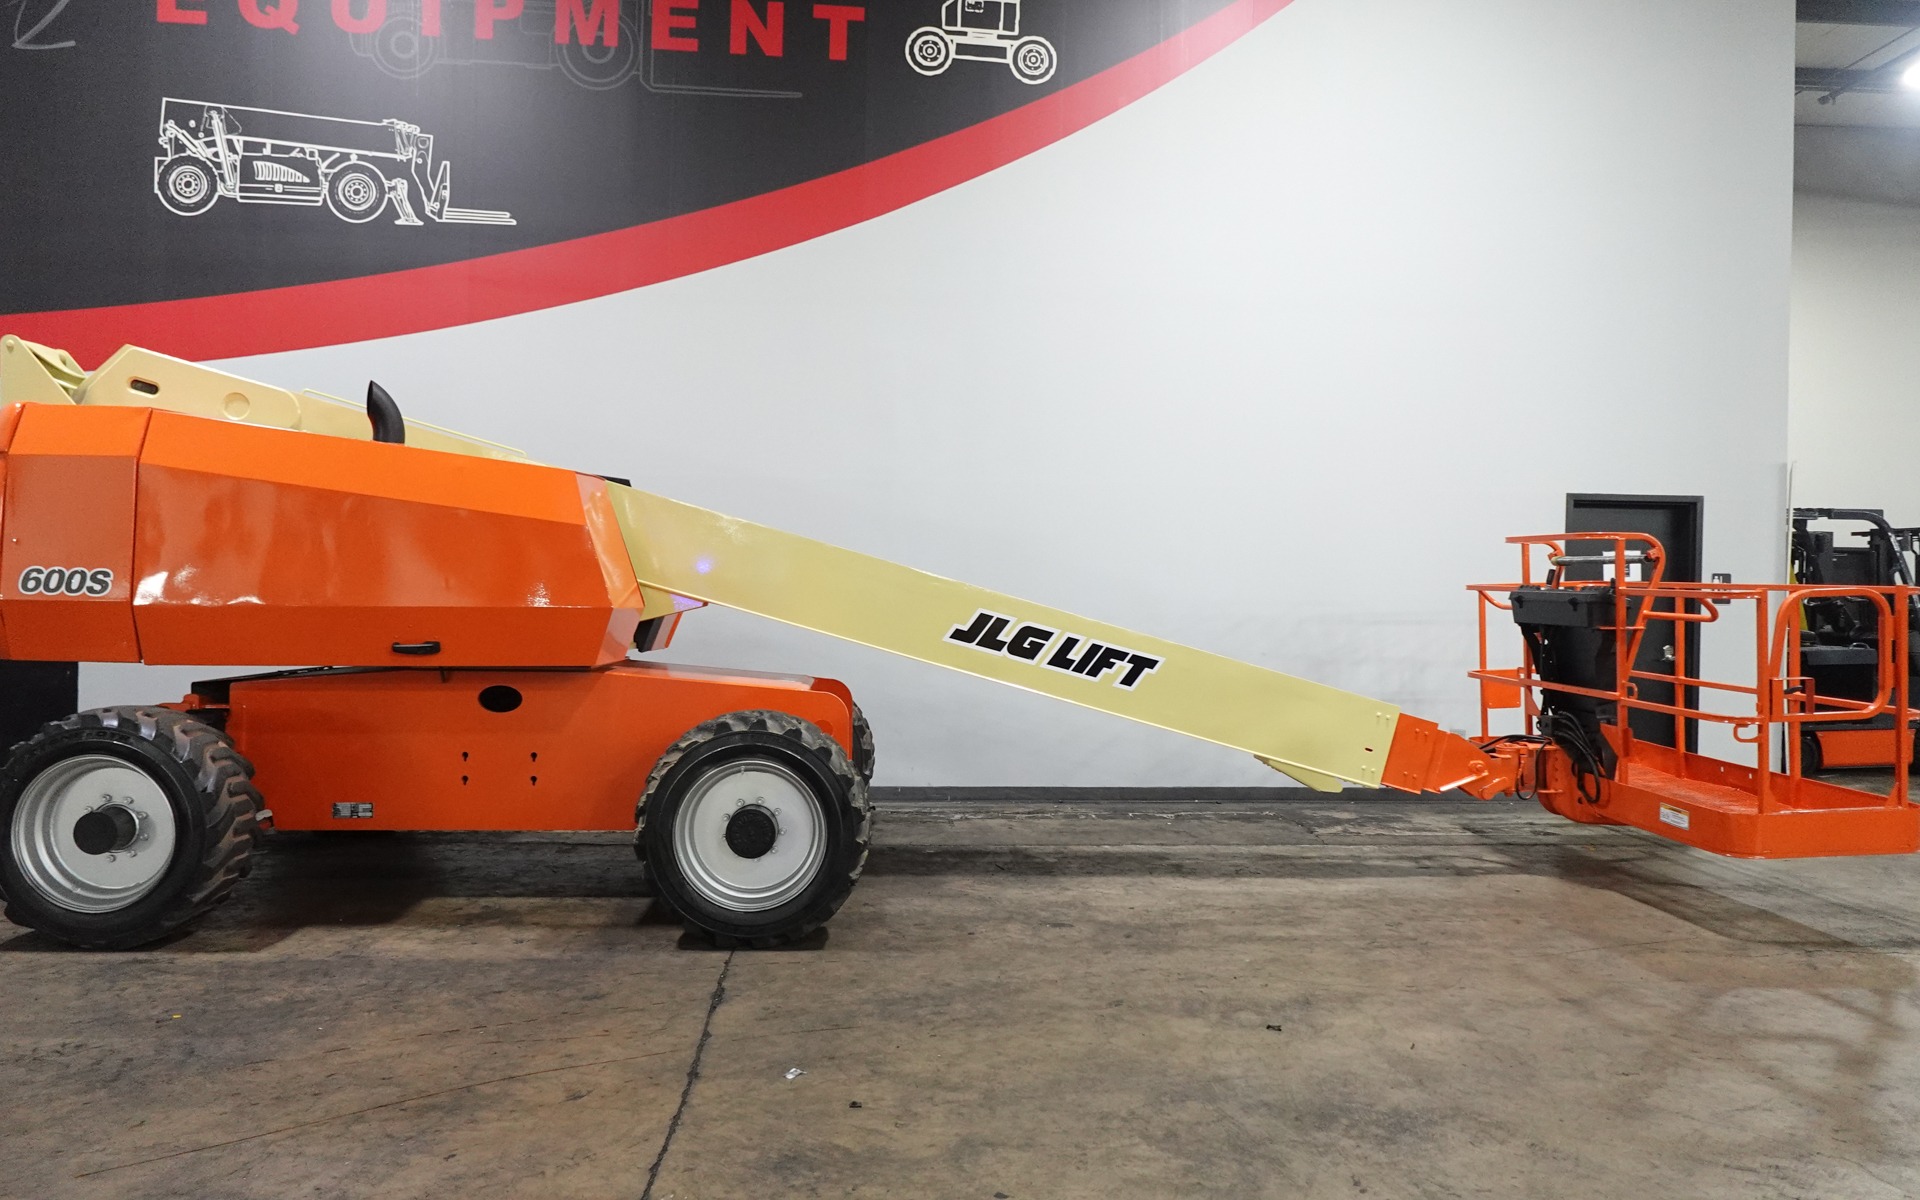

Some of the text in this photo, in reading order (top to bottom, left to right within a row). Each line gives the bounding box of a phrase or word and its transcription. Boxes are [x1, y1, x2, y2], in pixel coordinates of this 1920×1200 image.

[20, 566, 112, 596] 600S
[948, 611, 1161, 689] JLG LIFT
